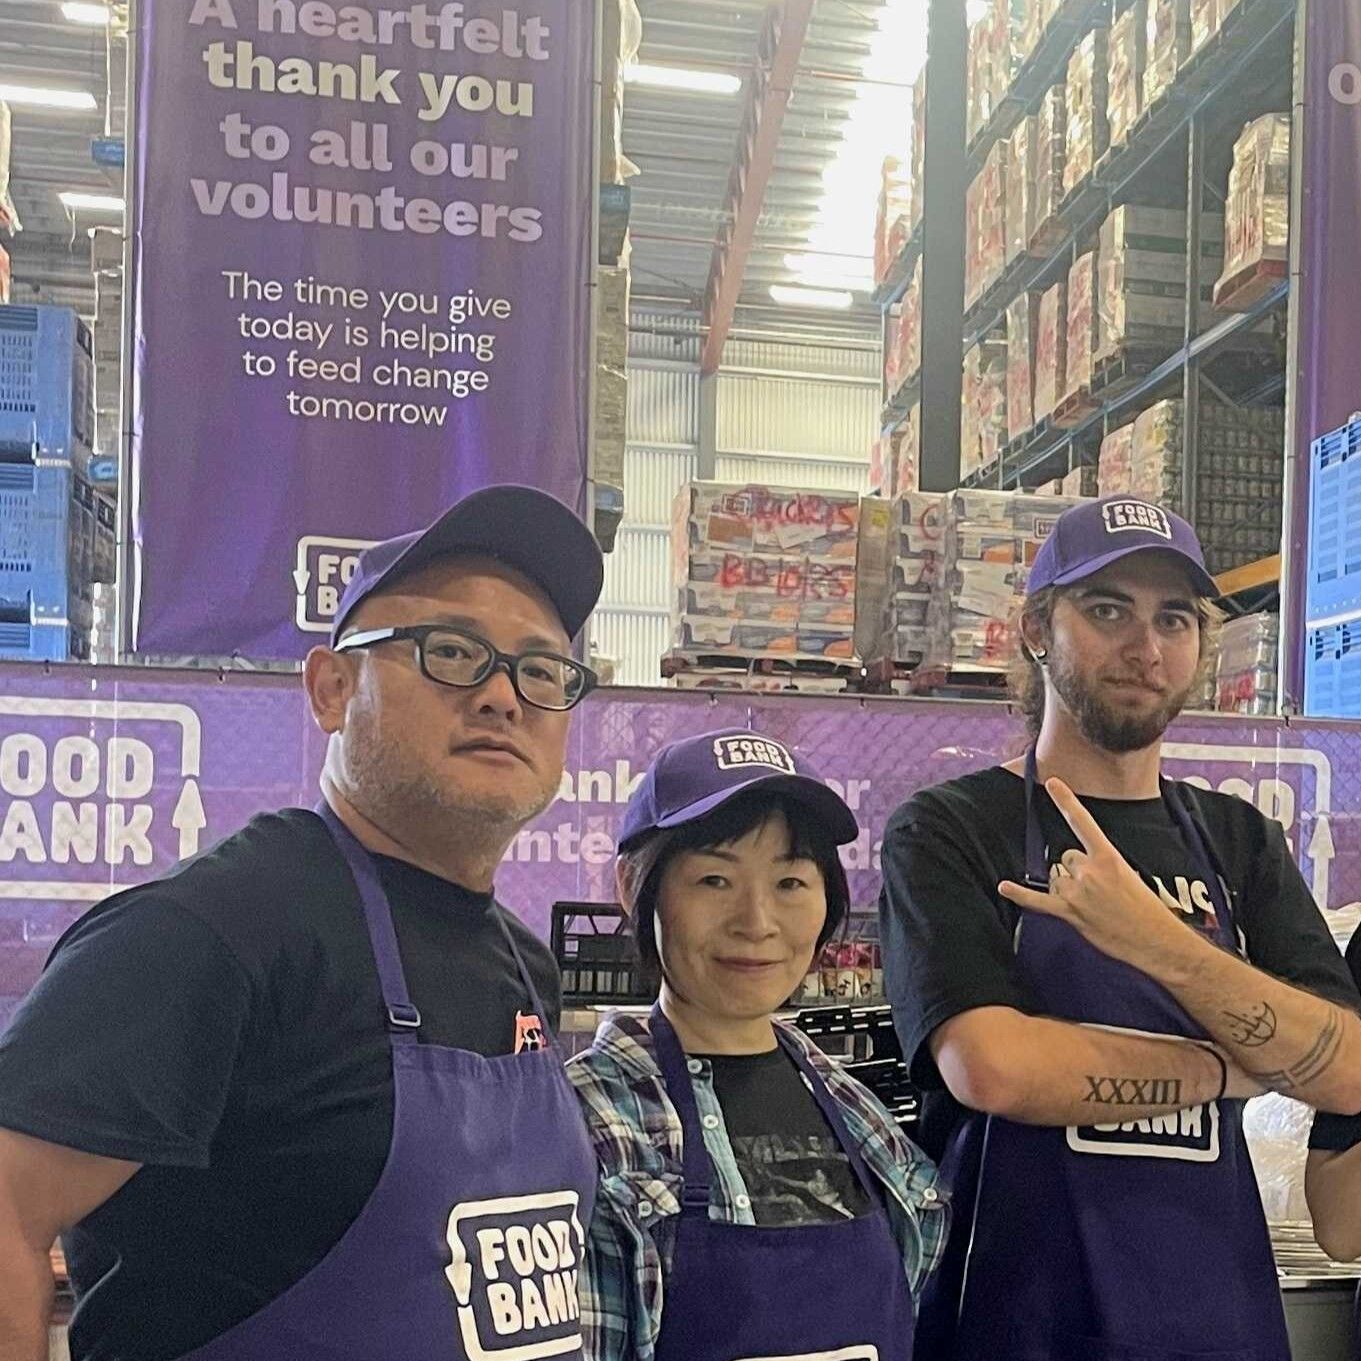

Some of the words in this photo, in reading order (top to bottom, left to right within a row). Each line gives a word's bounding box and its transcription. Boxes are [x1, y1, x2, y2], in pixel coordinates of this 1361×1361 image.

[189, 0, 238, 29] A
[258, 0, 550, 60] heartfelt
[203, 40, 401, 104] thank
[417, 72, 534, 121] you
[220, 112, 291, 162] to
[309, 120, 393, 172] all
[410, 139, 519, 181] our
[190, 172, 544, 243] volunteers
[222, 271, 283, 301] The
[294, 276, 369, 309] time
[380, 290, 438, 318] you
[449, 289, 512, 324] give
[238, 312, 333, 349] today
[345, 318, 369, 347] is
[380, 321, 496, 361] helping
[242, 351, 276, 376] to
[287, 350, 361, 384] feed
[372, 359, 489, 398] change
[286, 391, 447, 427] tomorrow
[1113, 504, 1158, 519] FOOD
[1115, 514, 1162, 531] BANK
[318, 554, 361, 585] FO
[0, 733, 154, 799] OOD
[727, 740, 779, 756] FOOD
[730, 751, 784, 767] BANK
[0, 800, 153, 865] ANK
[1083, 1075, 1182, 1106] XXXIII
[477, 1220, 576, 1280] FOOD
[487, 1269, 580, 1335] BANK
